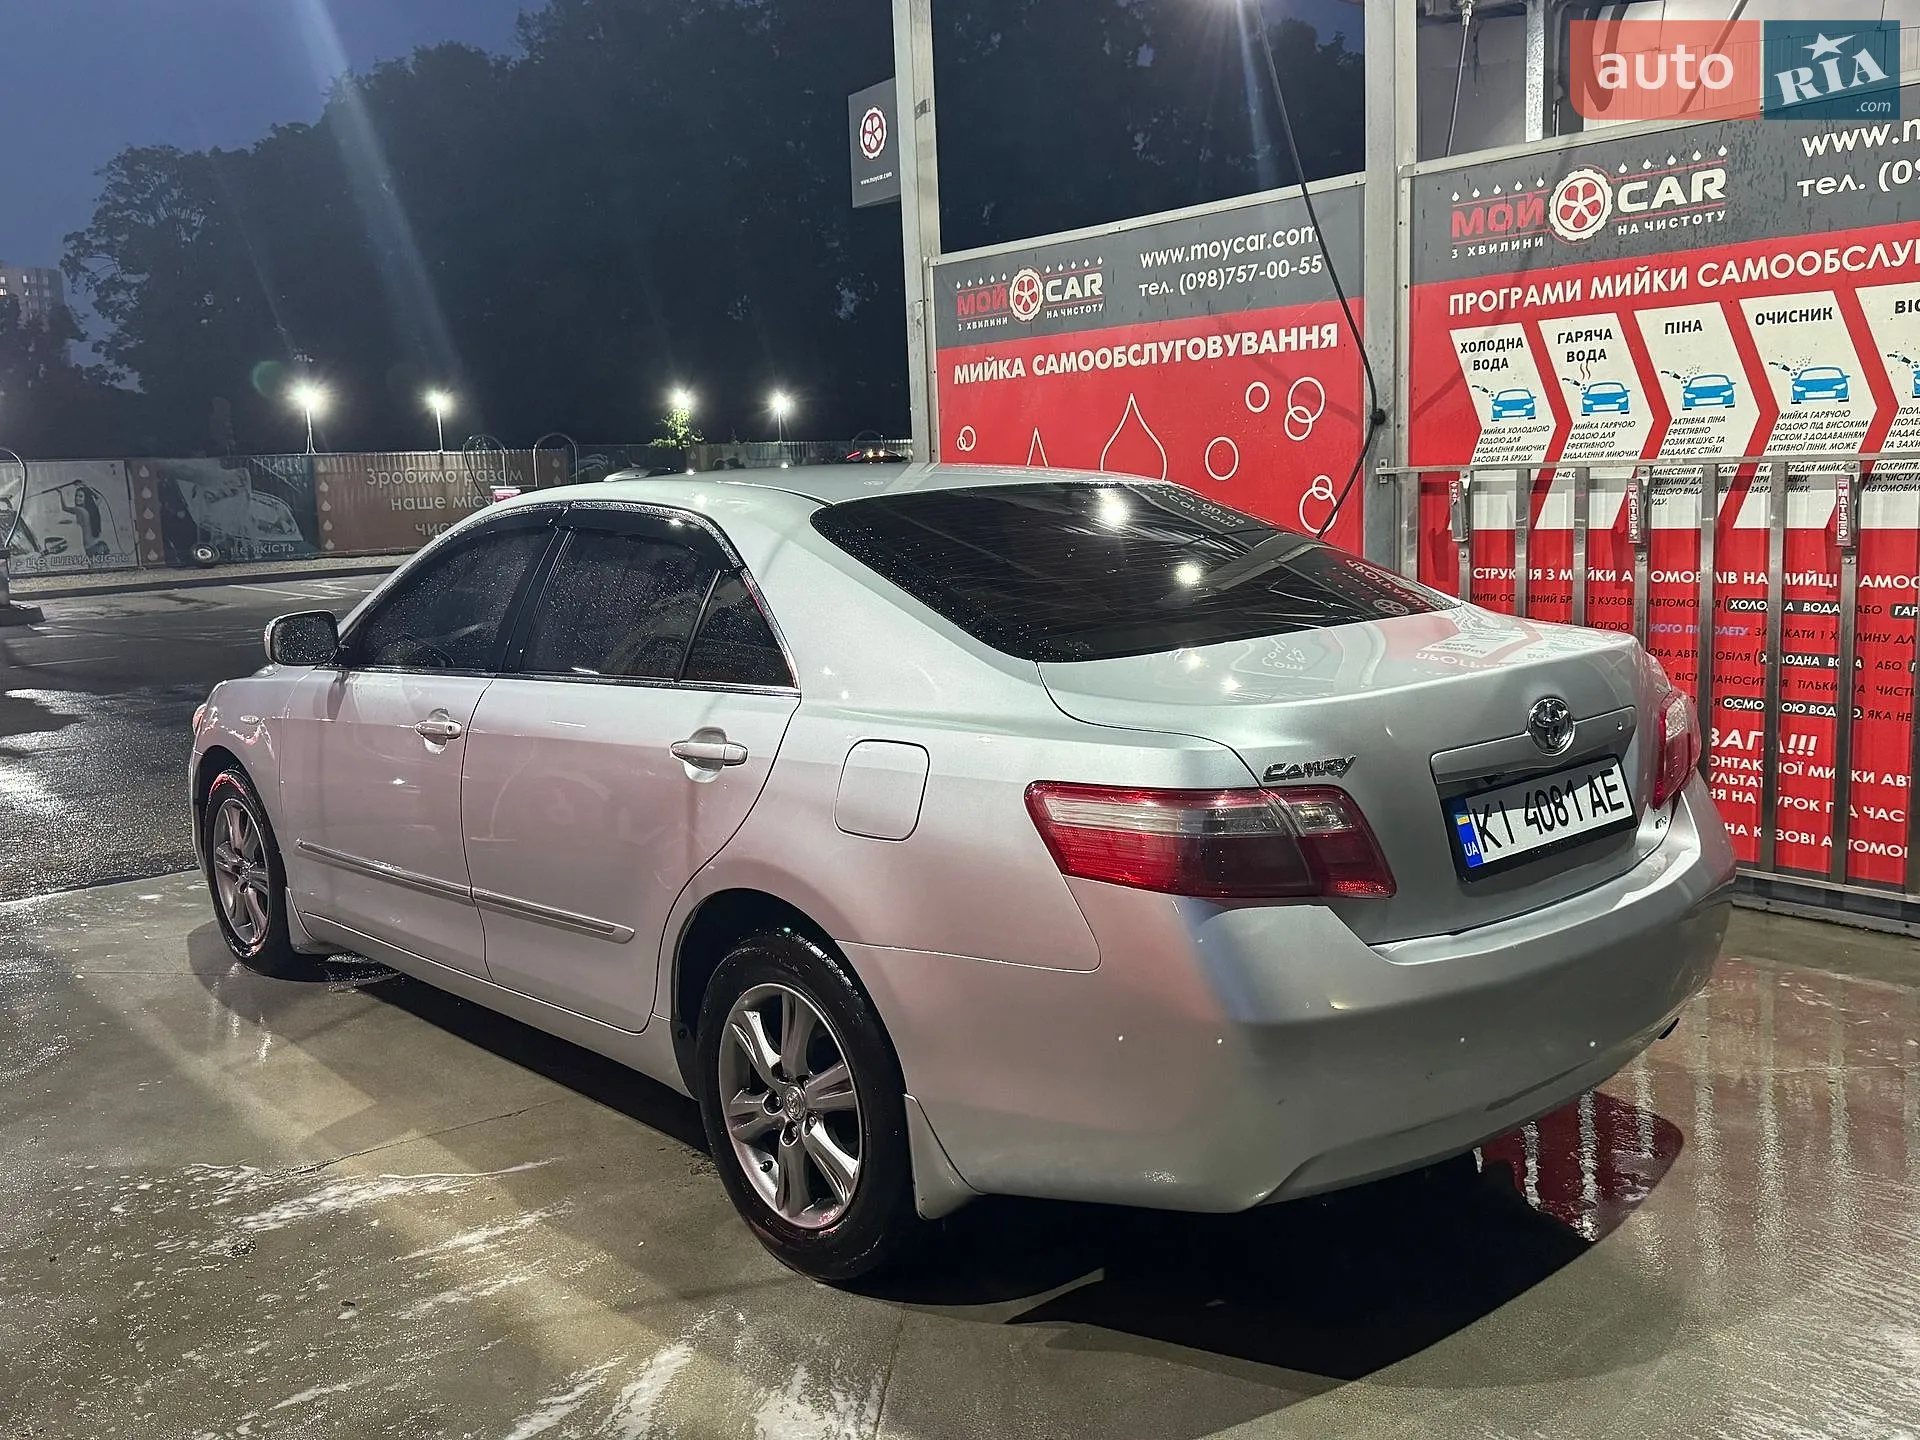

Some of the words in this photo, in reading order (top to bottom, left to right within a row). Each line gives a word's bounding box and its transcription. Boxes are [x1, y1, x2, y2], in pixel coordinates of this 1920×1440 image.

[1617, 168, 1727, 213] CAR
[1797, 174, 1866, 197] тел.
[1451, 192, 1544, 238] МОЙ
[1645, 211, 1726, 232] ЧИСТОТУ
[1140, 225, 1318, 269] www.moycar.com
[1467, 237, 1544, 257] ХВИЛИНИ
[1138, 281, 1174, 297] тел.
[1179, 254, 1323, 296] (098)757-00-55
[1449, 279, 1582, 316] ПРОГРАМИ
[1590, 267, 1688, 301] МИЙКИ
[1698, 241, 1920, 286] САМООБСЛУ
[1045, 272, 1103, 302] CAR
[957, 285, 1008, 315] МОЙ
[1060, 303, 1104, 318] ЧИСТОТУ
[1755, 307, 1834, 326] ОЧИСНИК
[966, 317, 1008, 331] ХВИЛИНИ
[1664, 319, 1703, 335] ПІНА
[1557, 328, 1613, 345] ГАРЯЧА
[1460, 337, 1524, 354] ХОЛОДНА
[953, 356, 1026, 385] МИЙКА
[1032, 323, 1338, 375] САМООБСЛУГОВУВАННЯ
[1566, 348, 1607, 364] ВОДА
[1472, 357, 1509, 373] ВОДА
[1671, 416, 1706, 425] АКТИВНА
[1707, 415, 1726, 424] ПІНА
[1779, 410, 1809, 420] МИЙКА
[1810, 409, 1851, 419] ГАРЯЧОЮ
[1482, 426, 1506, 435] МИЙКА
[1507, 425, 1550, 434] ХОЛОДНОЮ
[1573, 421, 1599, 430] МИЙКА
[1600, 420, 1636, 429] ГАРЯЧОЮ
[1668, 426, 1711, 436] ЕФЕКТИВНО
[1775, 422, 1808, 431] ВОДОЮ
[1809, 421, 1824, 431] ПІД
[1825, 419, 1869, 430] ВИСОКИМ
[1479, 437, 1505, 445] ВОДОЮ
[1506, 436, 1521, 444] ДЛЯ
[1570, 432, 1599, 440] ВОДОЮ
[1600, 431, 1616, 439] ДЛЯ
[1716, 436, 1726, 445] ТА
[1770, 433, 1802, 442] ТИСКОМ
[1809, 431, 1866, 441] ДОДАВАННЯМ
[1476, 446, 1514, 454] ВИДАЛЕННЯ
[1514, 444, 1546, 452] МИЮЧИХ
[1566, 441, 1615, 450] ЕФЕКТИВНОГО
[1660, 447, 1696, 456] ВИДАЛЯЄ
[1697, 445, 1723, 454] СТІЙКІ
[1766, 442, 1806, 451] АКТИВНОЇ
[1829, 442, 1858, 450] МОЖЕ
[1884, 440, 1895, 449] ТА
[1473, 455, 1500, 463] ЗАСОБІВ
[1563, 450, 1604, 459] ВИДАЛЕННЯ
[1605, 449, 1640, 458] МИЮЧИХ
[367, 467, 457, 489] Зробимо
[464, 468, 523, 489] разом
[1652, 467, 1696, 476] НАНЕСЕННЯ
[1885, 473, 1914, 482] ЧИСТУ
[1753, 475, 1769, 483] ПРИ
[391, 495, 447, 511] наше
[1743, 571, 1769, 585] НА
[1875, 661, 1903, 671] АБО
[1867, 709, 1892, 721] ЯКА
[1262, 754, 1357, 783] CAMRY
[1523, 779, 1584, 835] 4081
[1731, 790, 1757, 804] НА
[1863, 806, 1905, 823] ЧАС
[1463, 843, 1480, 857] UA
